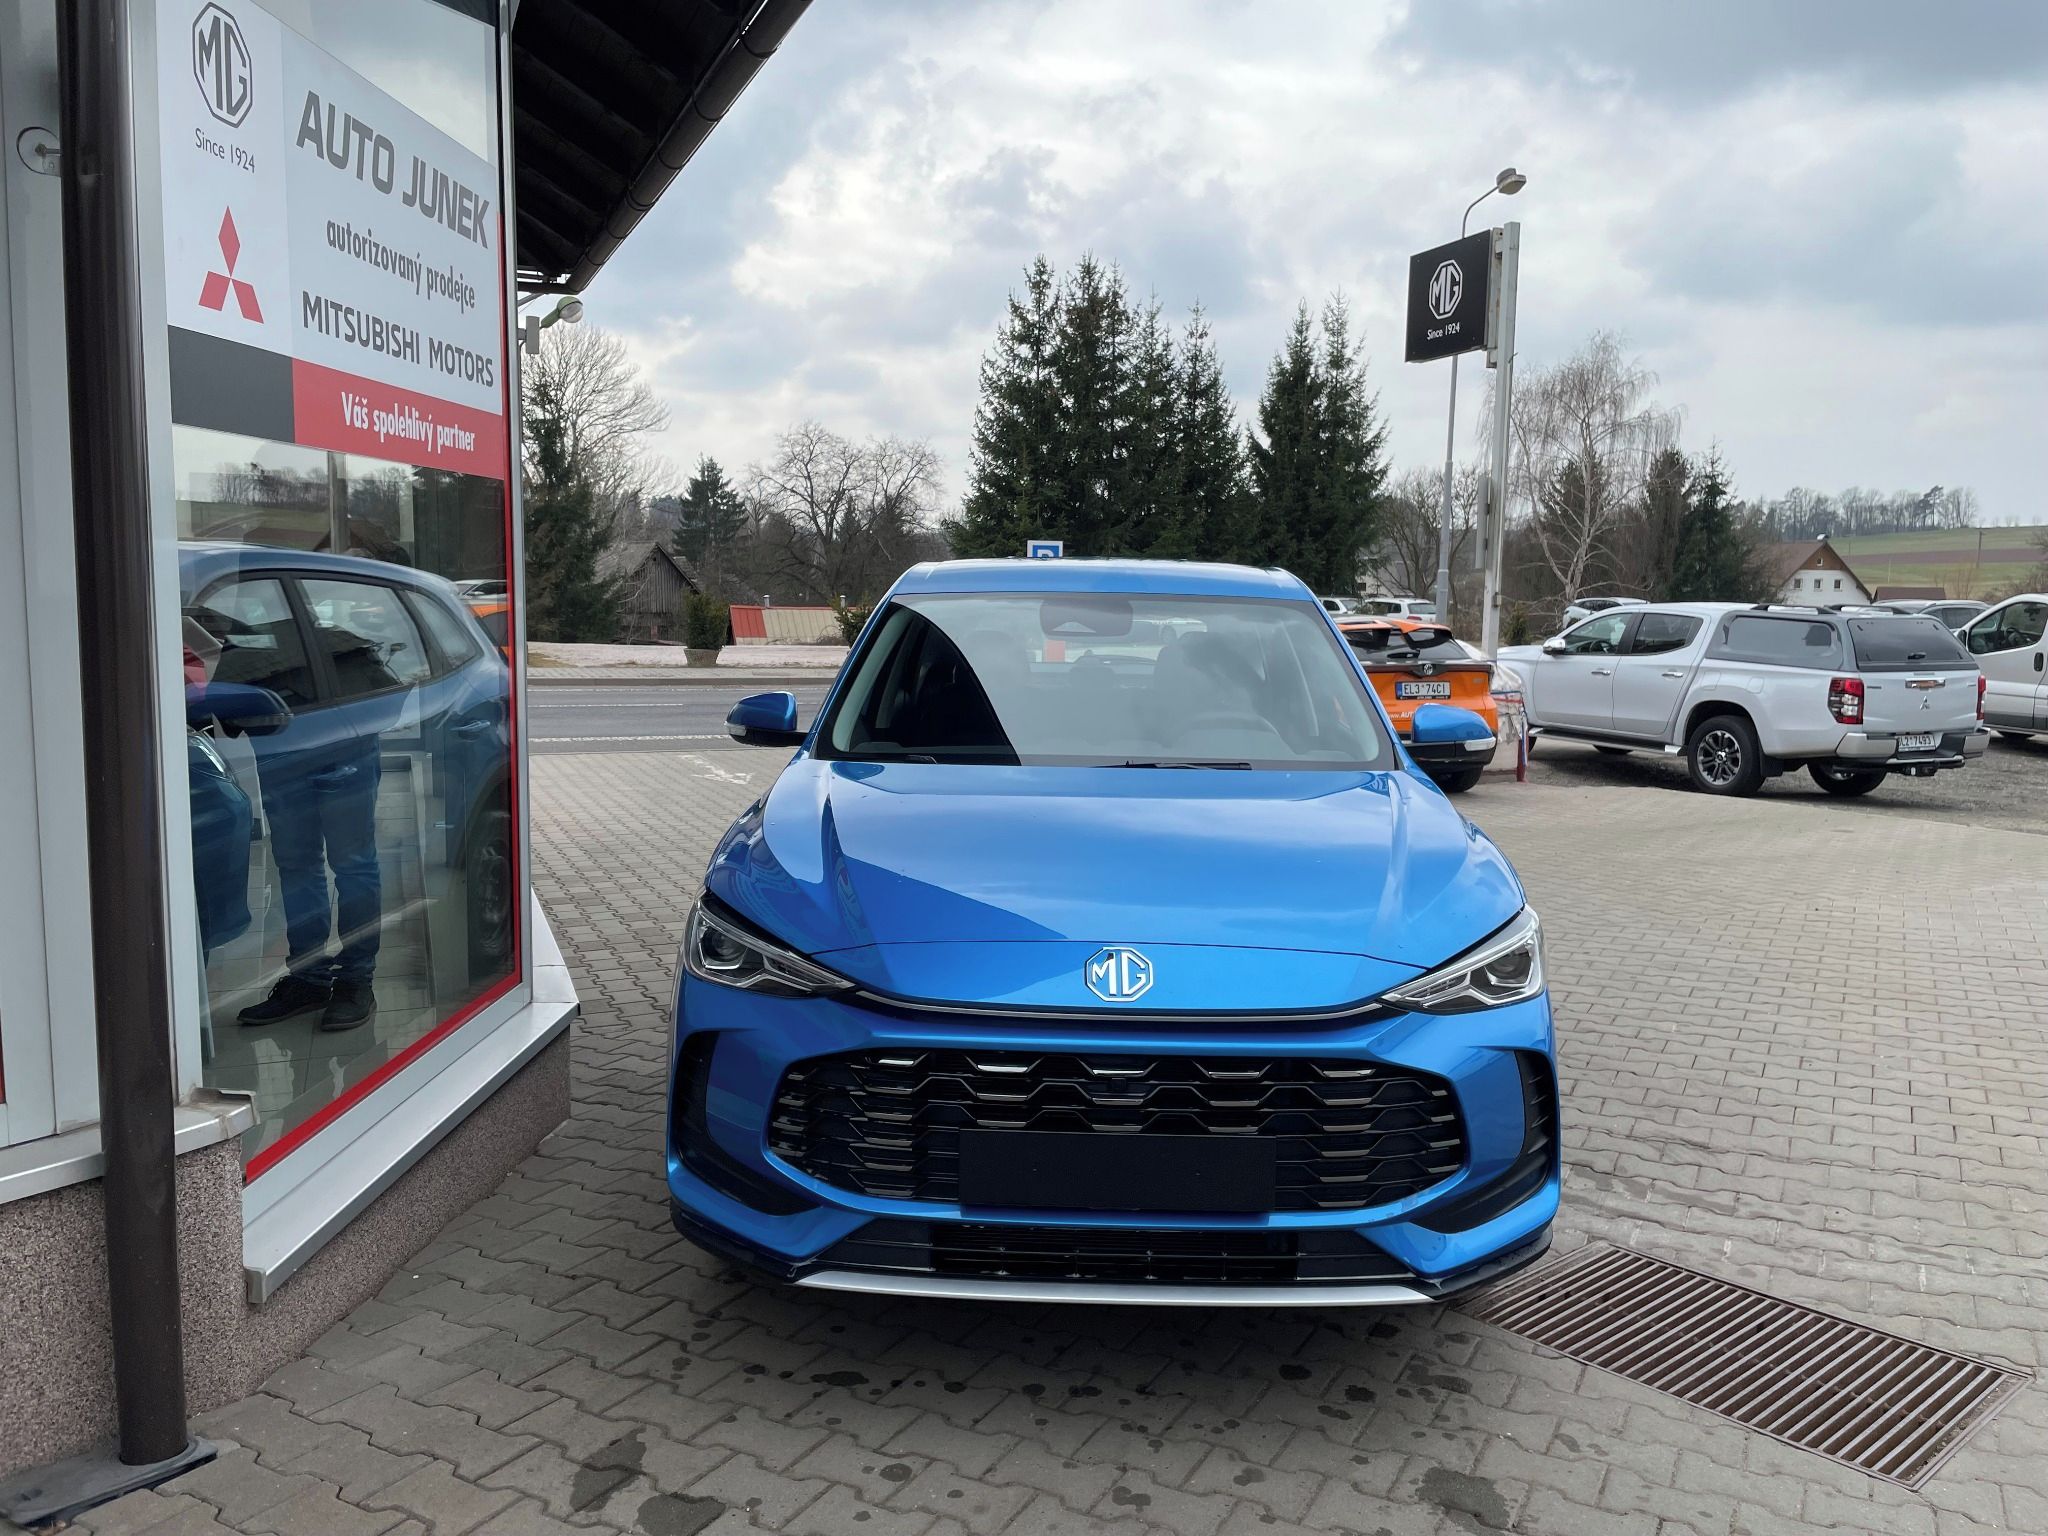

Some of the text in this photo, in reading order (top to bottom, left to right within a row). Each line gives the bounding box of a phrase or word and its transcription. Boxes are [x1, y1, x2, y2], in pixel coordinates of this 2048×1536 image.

[197, 12, 249, 118] MG
[195, 127, 255, 174] Since 1924
[296, 89, 490, 249] AUTO JUNEK
[326, 219, 475, 315] autorizovaný prodejce
[1431, 264, 1460, 315] MG
[302, 289, 494, 388] MITSUBISHI MOTORS
[1427, 322, 1460, 340] Since 1924
[341, 391, 476, 454] Váš spolehlivý partner
[1091, 950, 1148, 997] MG
